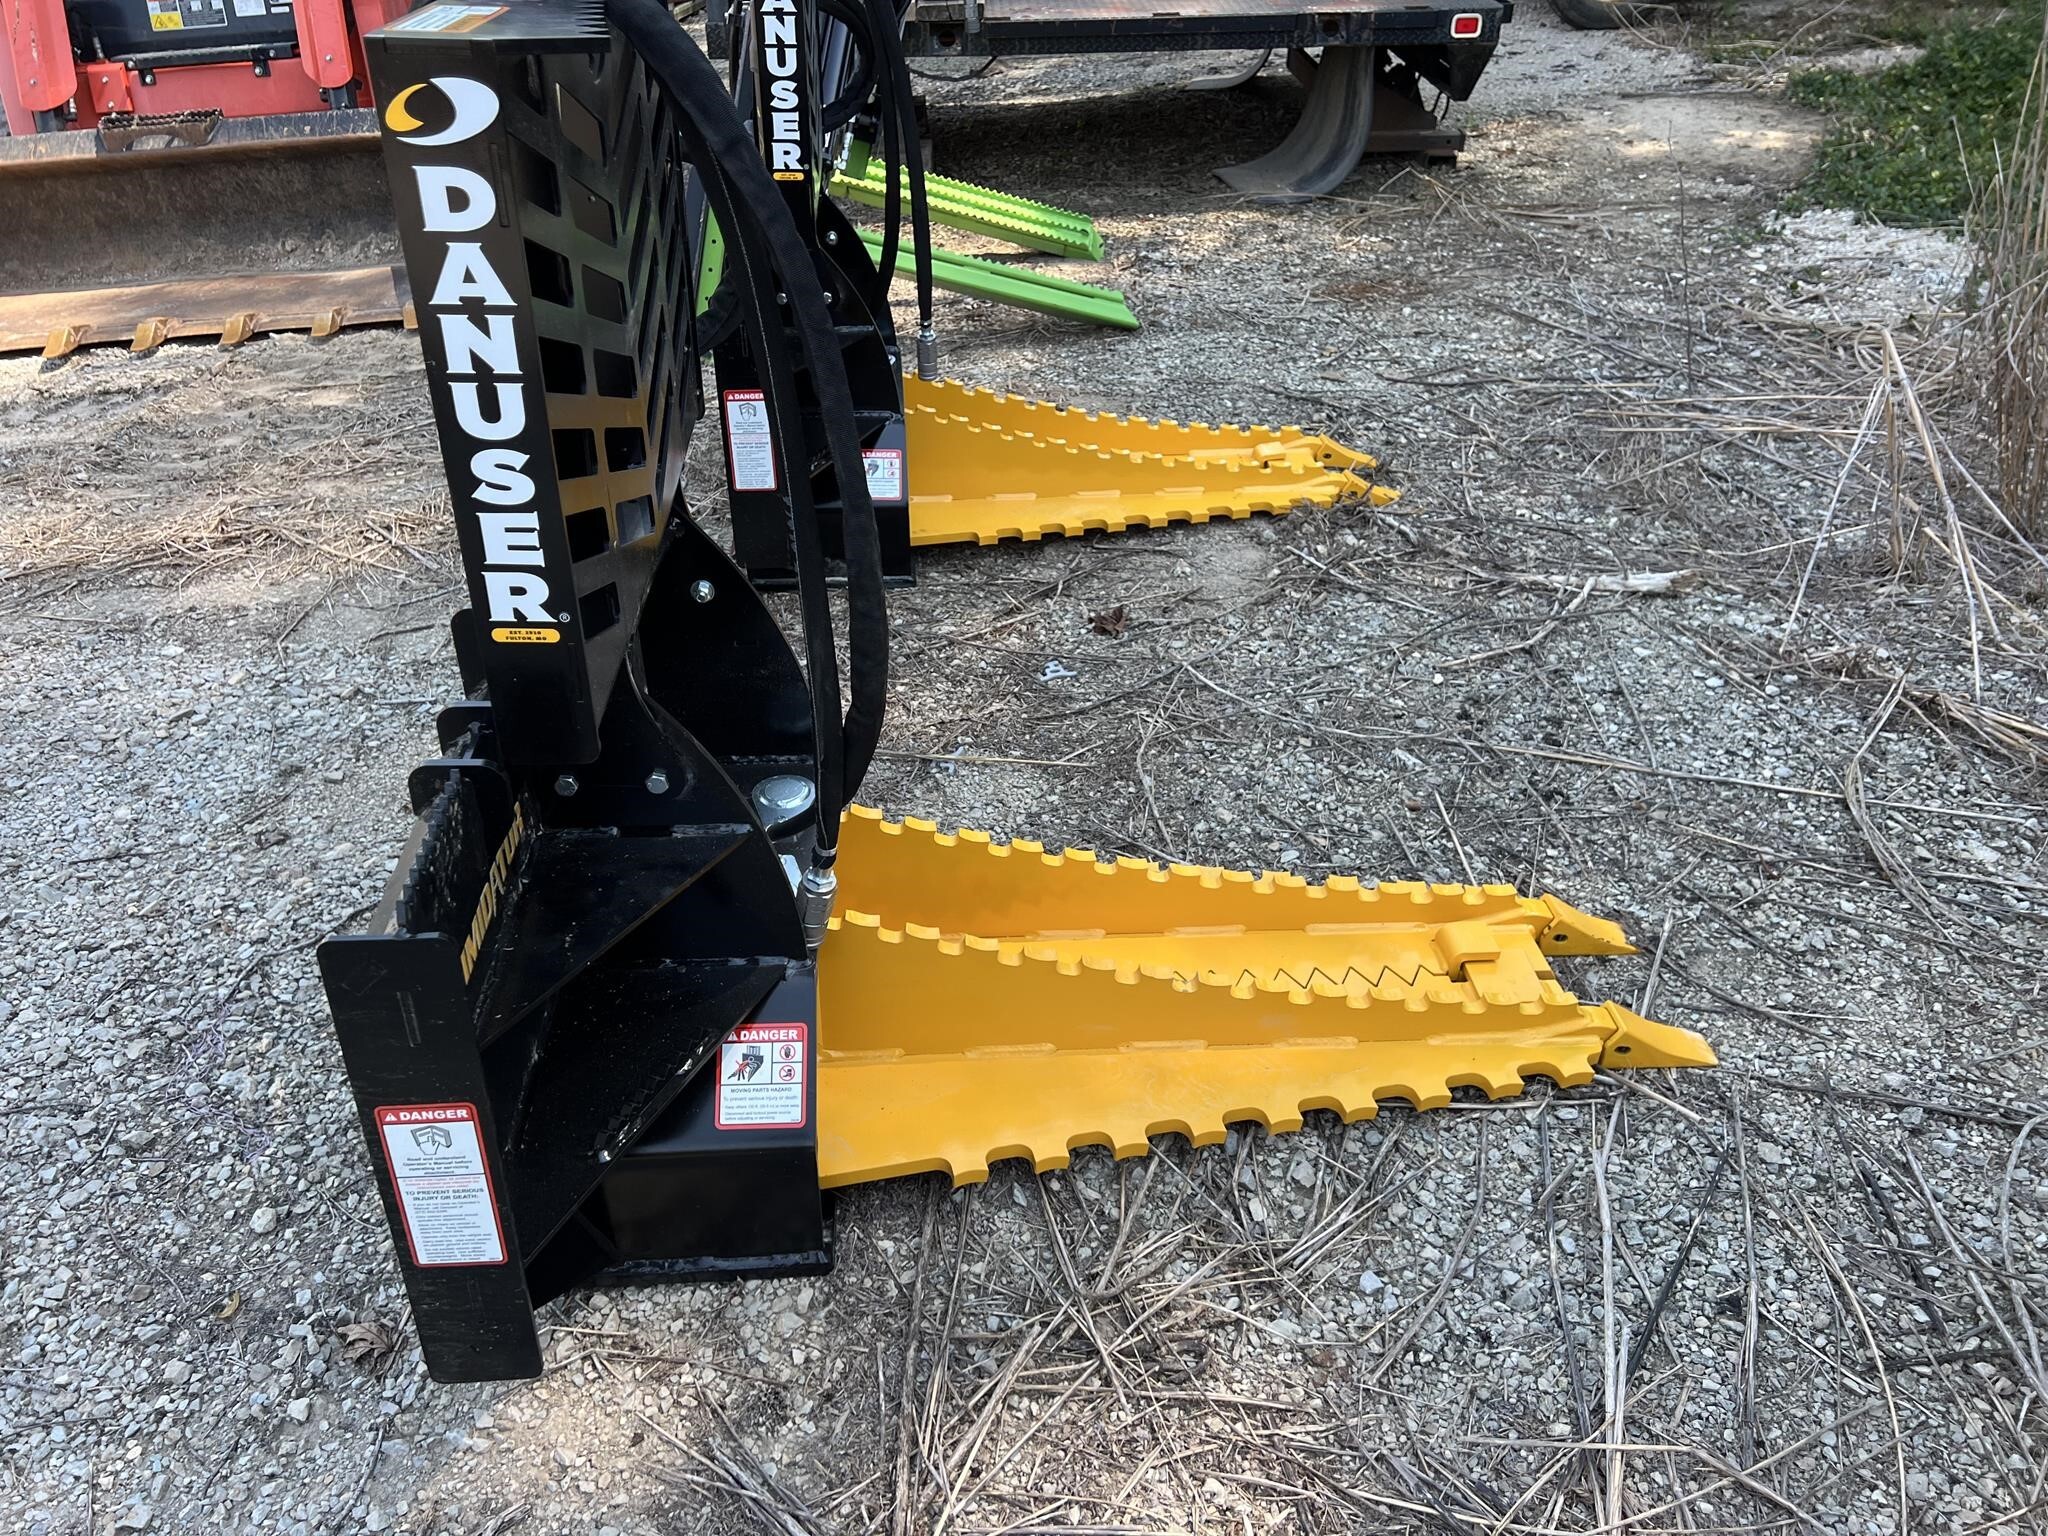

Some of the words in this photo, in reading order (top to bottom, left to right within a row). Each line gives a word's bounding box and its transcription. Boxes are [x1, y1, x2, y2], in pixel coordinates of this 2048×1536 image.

[412, 166, 560, 623] DANUSER
[740, 1029, 798, 1041] DANGER
[399, 1109, 469, 1121] DANGER
